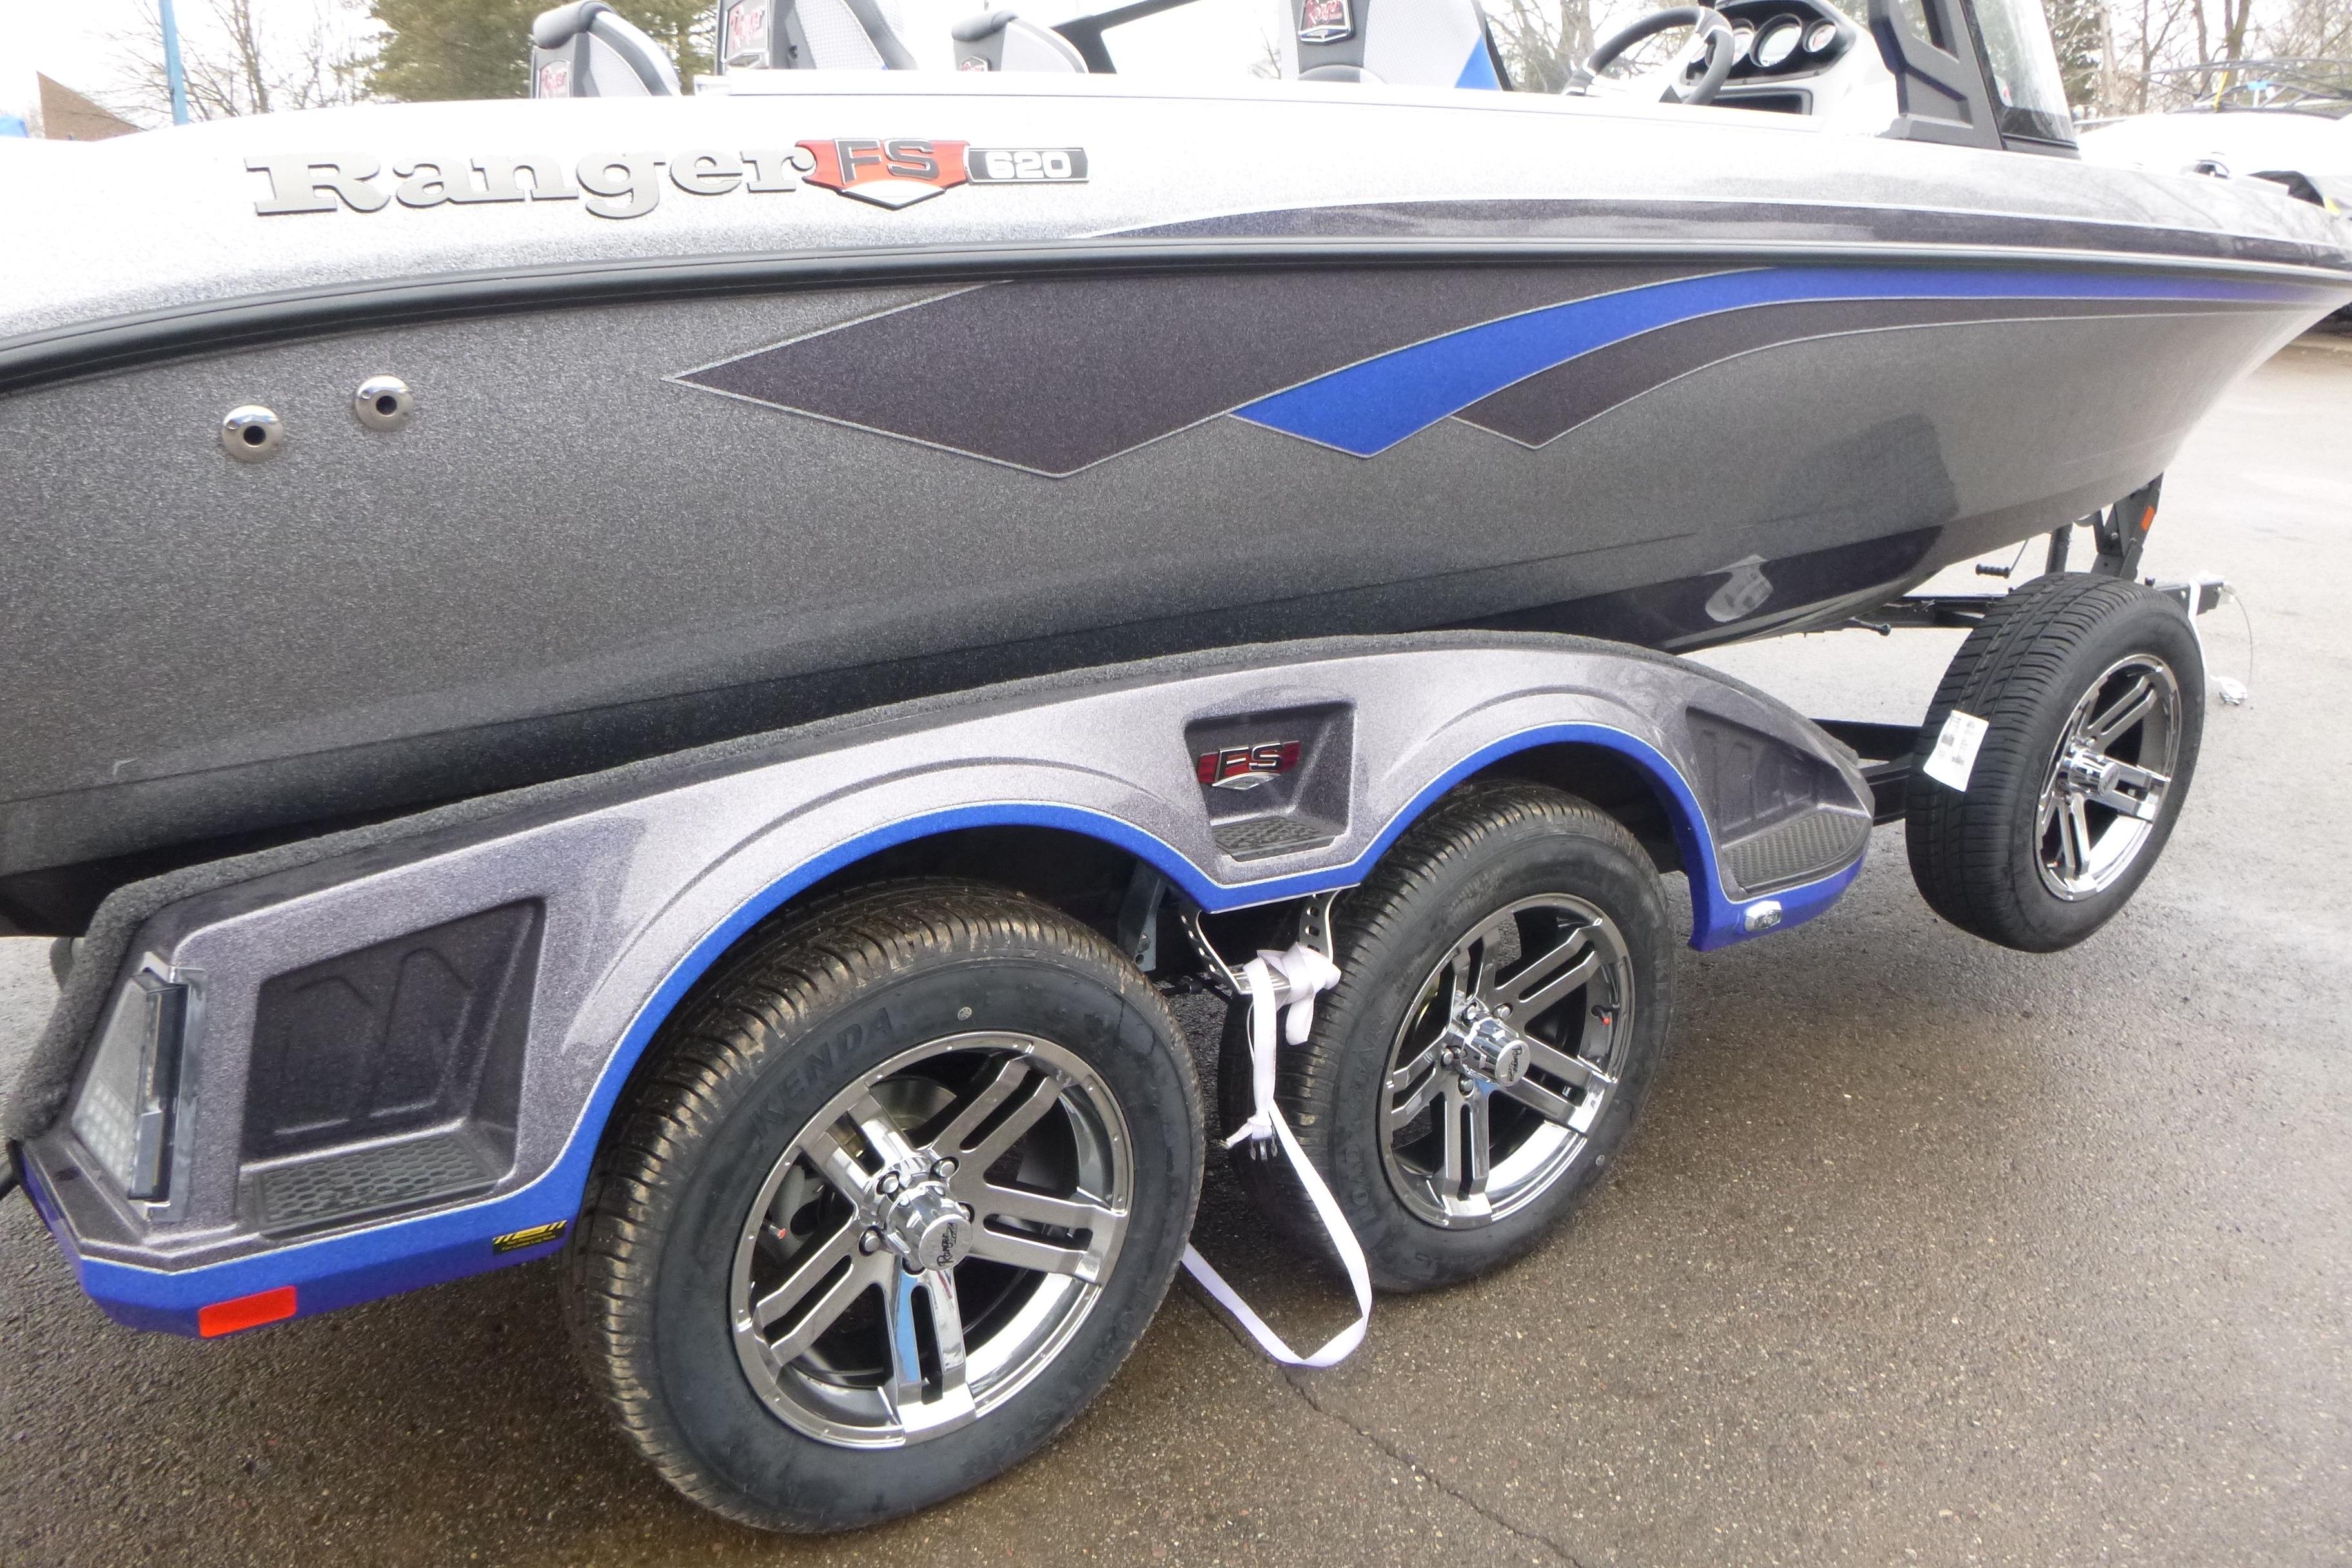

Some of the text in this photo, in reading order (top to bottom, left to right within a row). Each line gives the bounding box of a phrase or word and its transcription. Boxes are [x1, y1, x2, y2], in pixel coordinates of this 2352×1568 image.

[244, 138, 1072, 219] Ranger FS 620
[1213, 742, 1284, 784] FS
[748, 1006, 894, 1141] KENDA
[937, 1233, 954, 1267] Ranger
